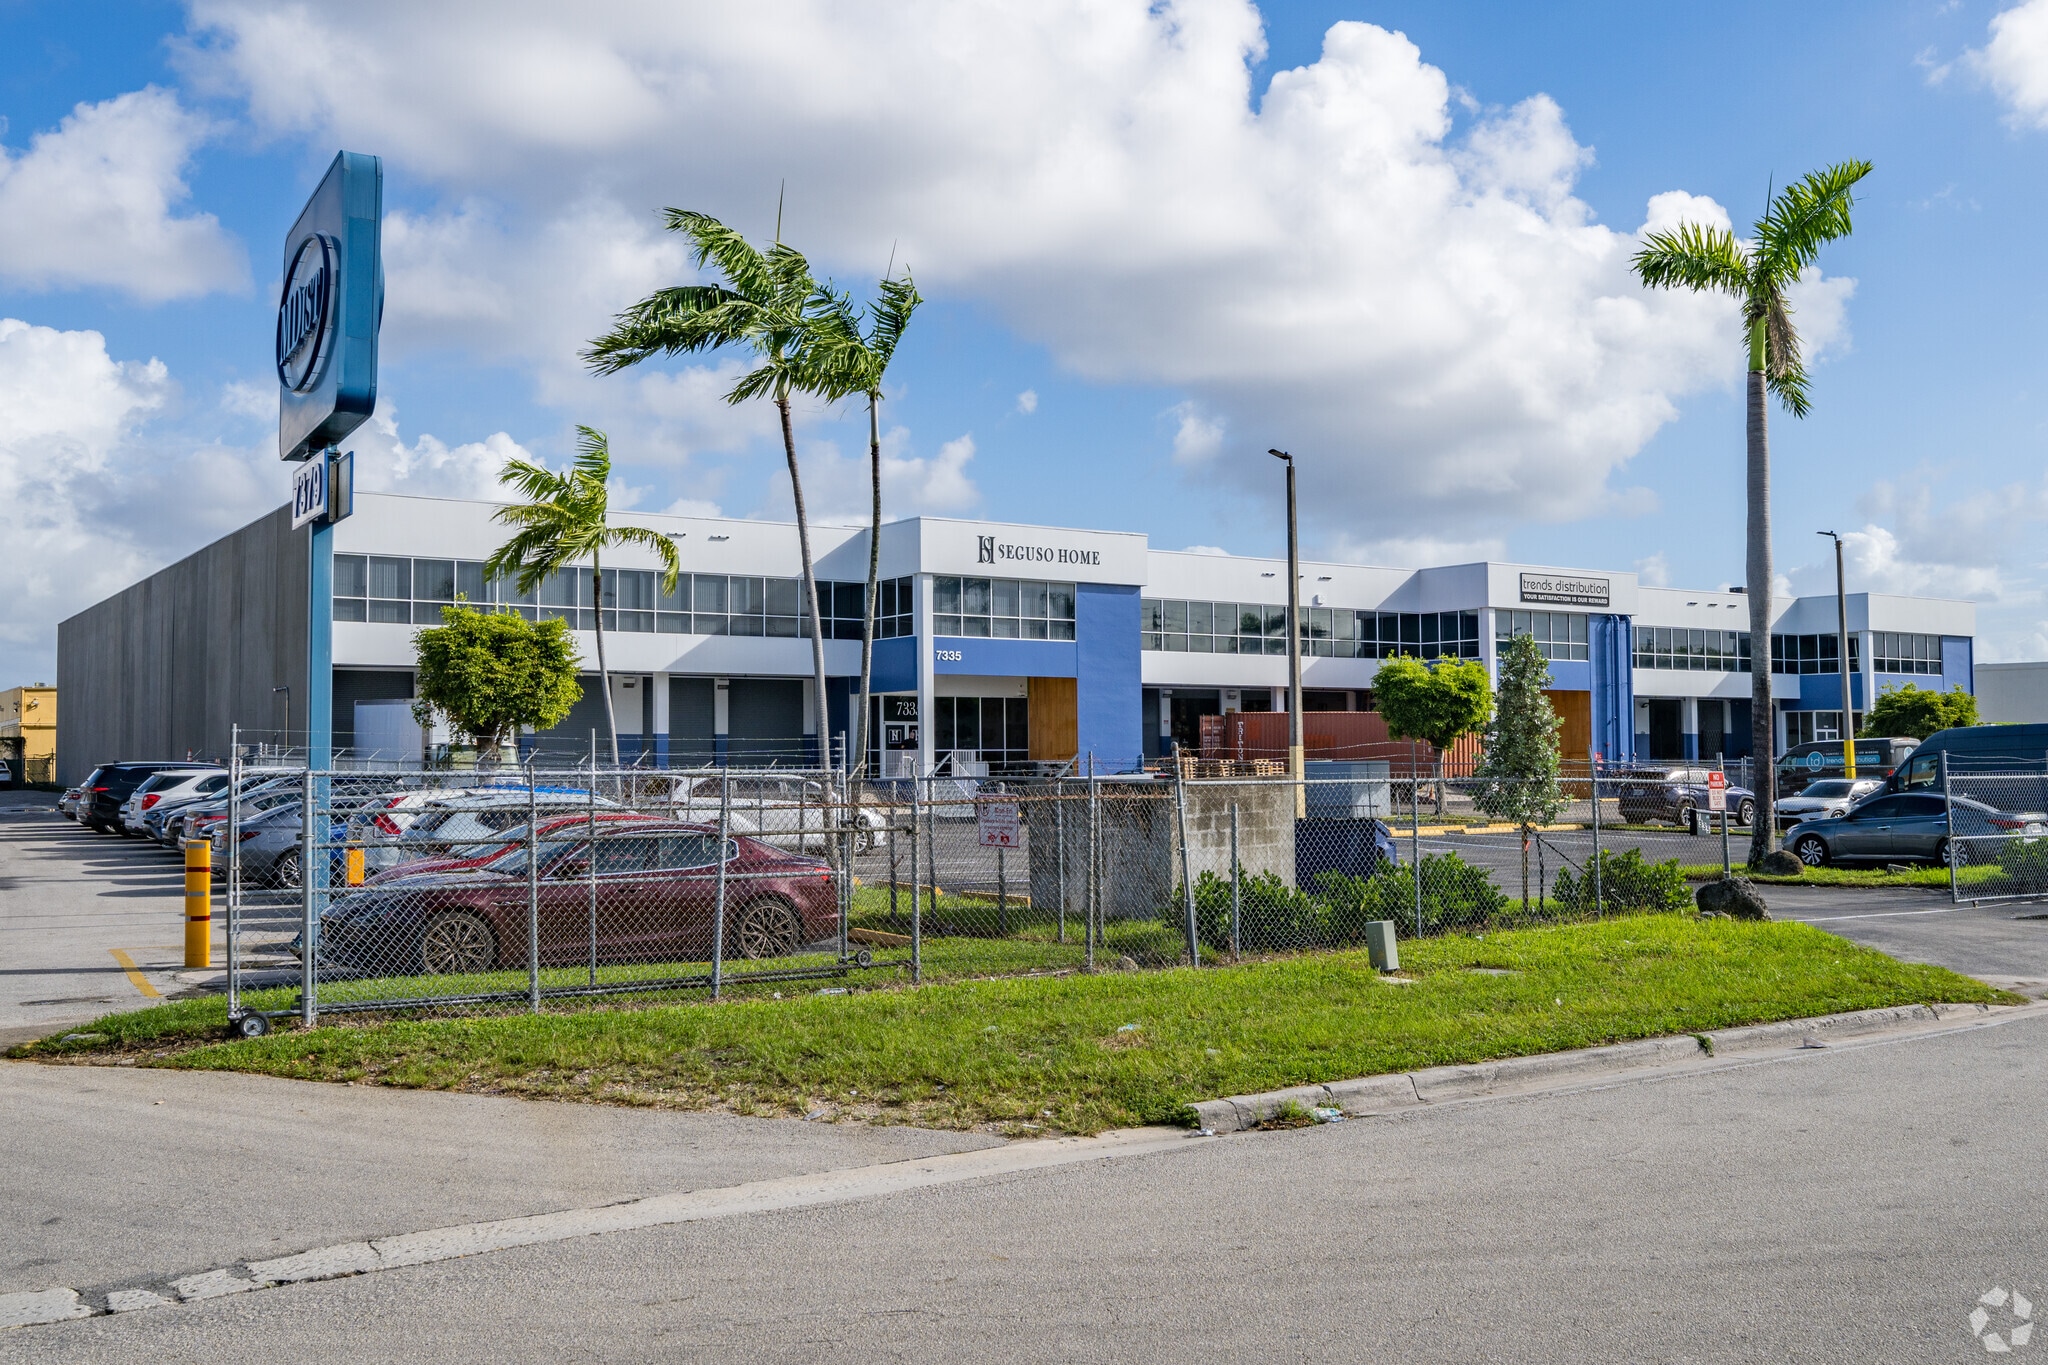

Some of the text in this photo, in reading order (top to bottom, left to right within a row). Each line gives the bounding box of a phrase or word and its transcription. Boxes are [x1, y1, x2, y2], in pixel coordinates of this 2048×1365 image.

[294, 463, 323, 518] 7379
[998, 543, 1054, 562] SEGUSO
[1058, 548, 1100, 565] HOME
[1523, 579, 1607, 594] trends distribution
[1538, 594, 1571, 602] SATISFACTION
[935, 650, 962, 661] 7335
[896, 701, 918, 716] 733
[1810, 757, 1820, 766] td
